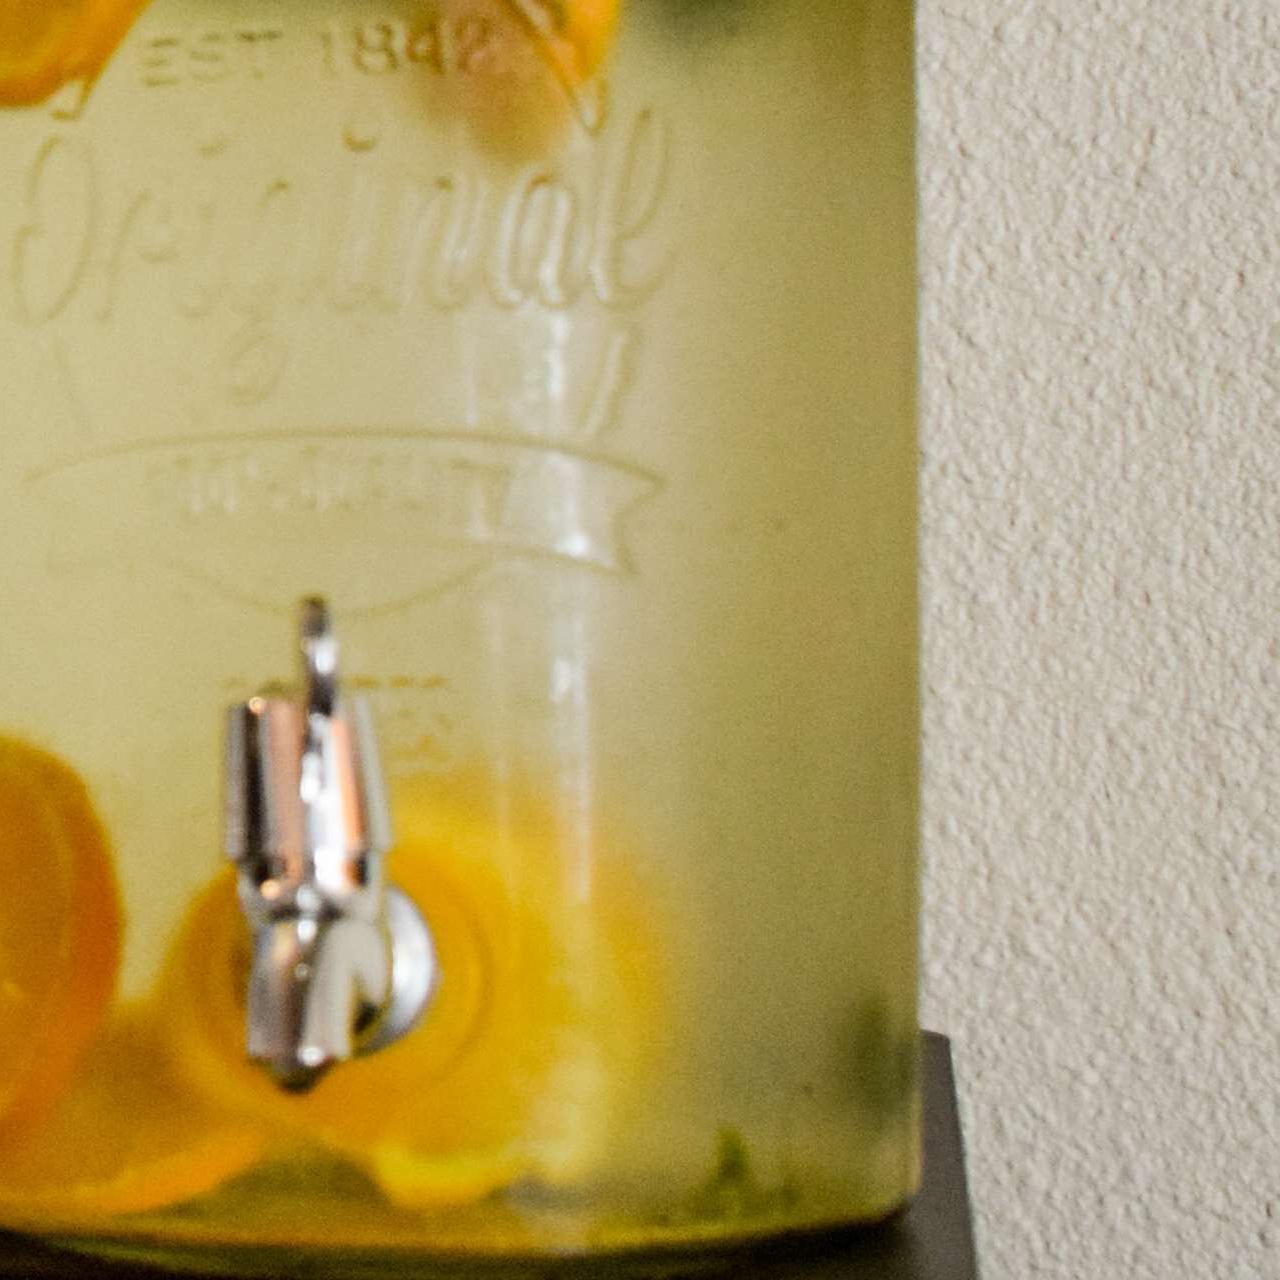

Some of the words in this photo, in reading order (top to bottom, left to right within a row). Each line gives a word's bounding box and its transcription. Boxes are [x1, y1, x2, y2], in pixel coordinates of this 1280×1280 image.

[143, 28, 283, 86] EST
[317, 18, 495, 76] 1842
[11, 106, 673, 406] Original
